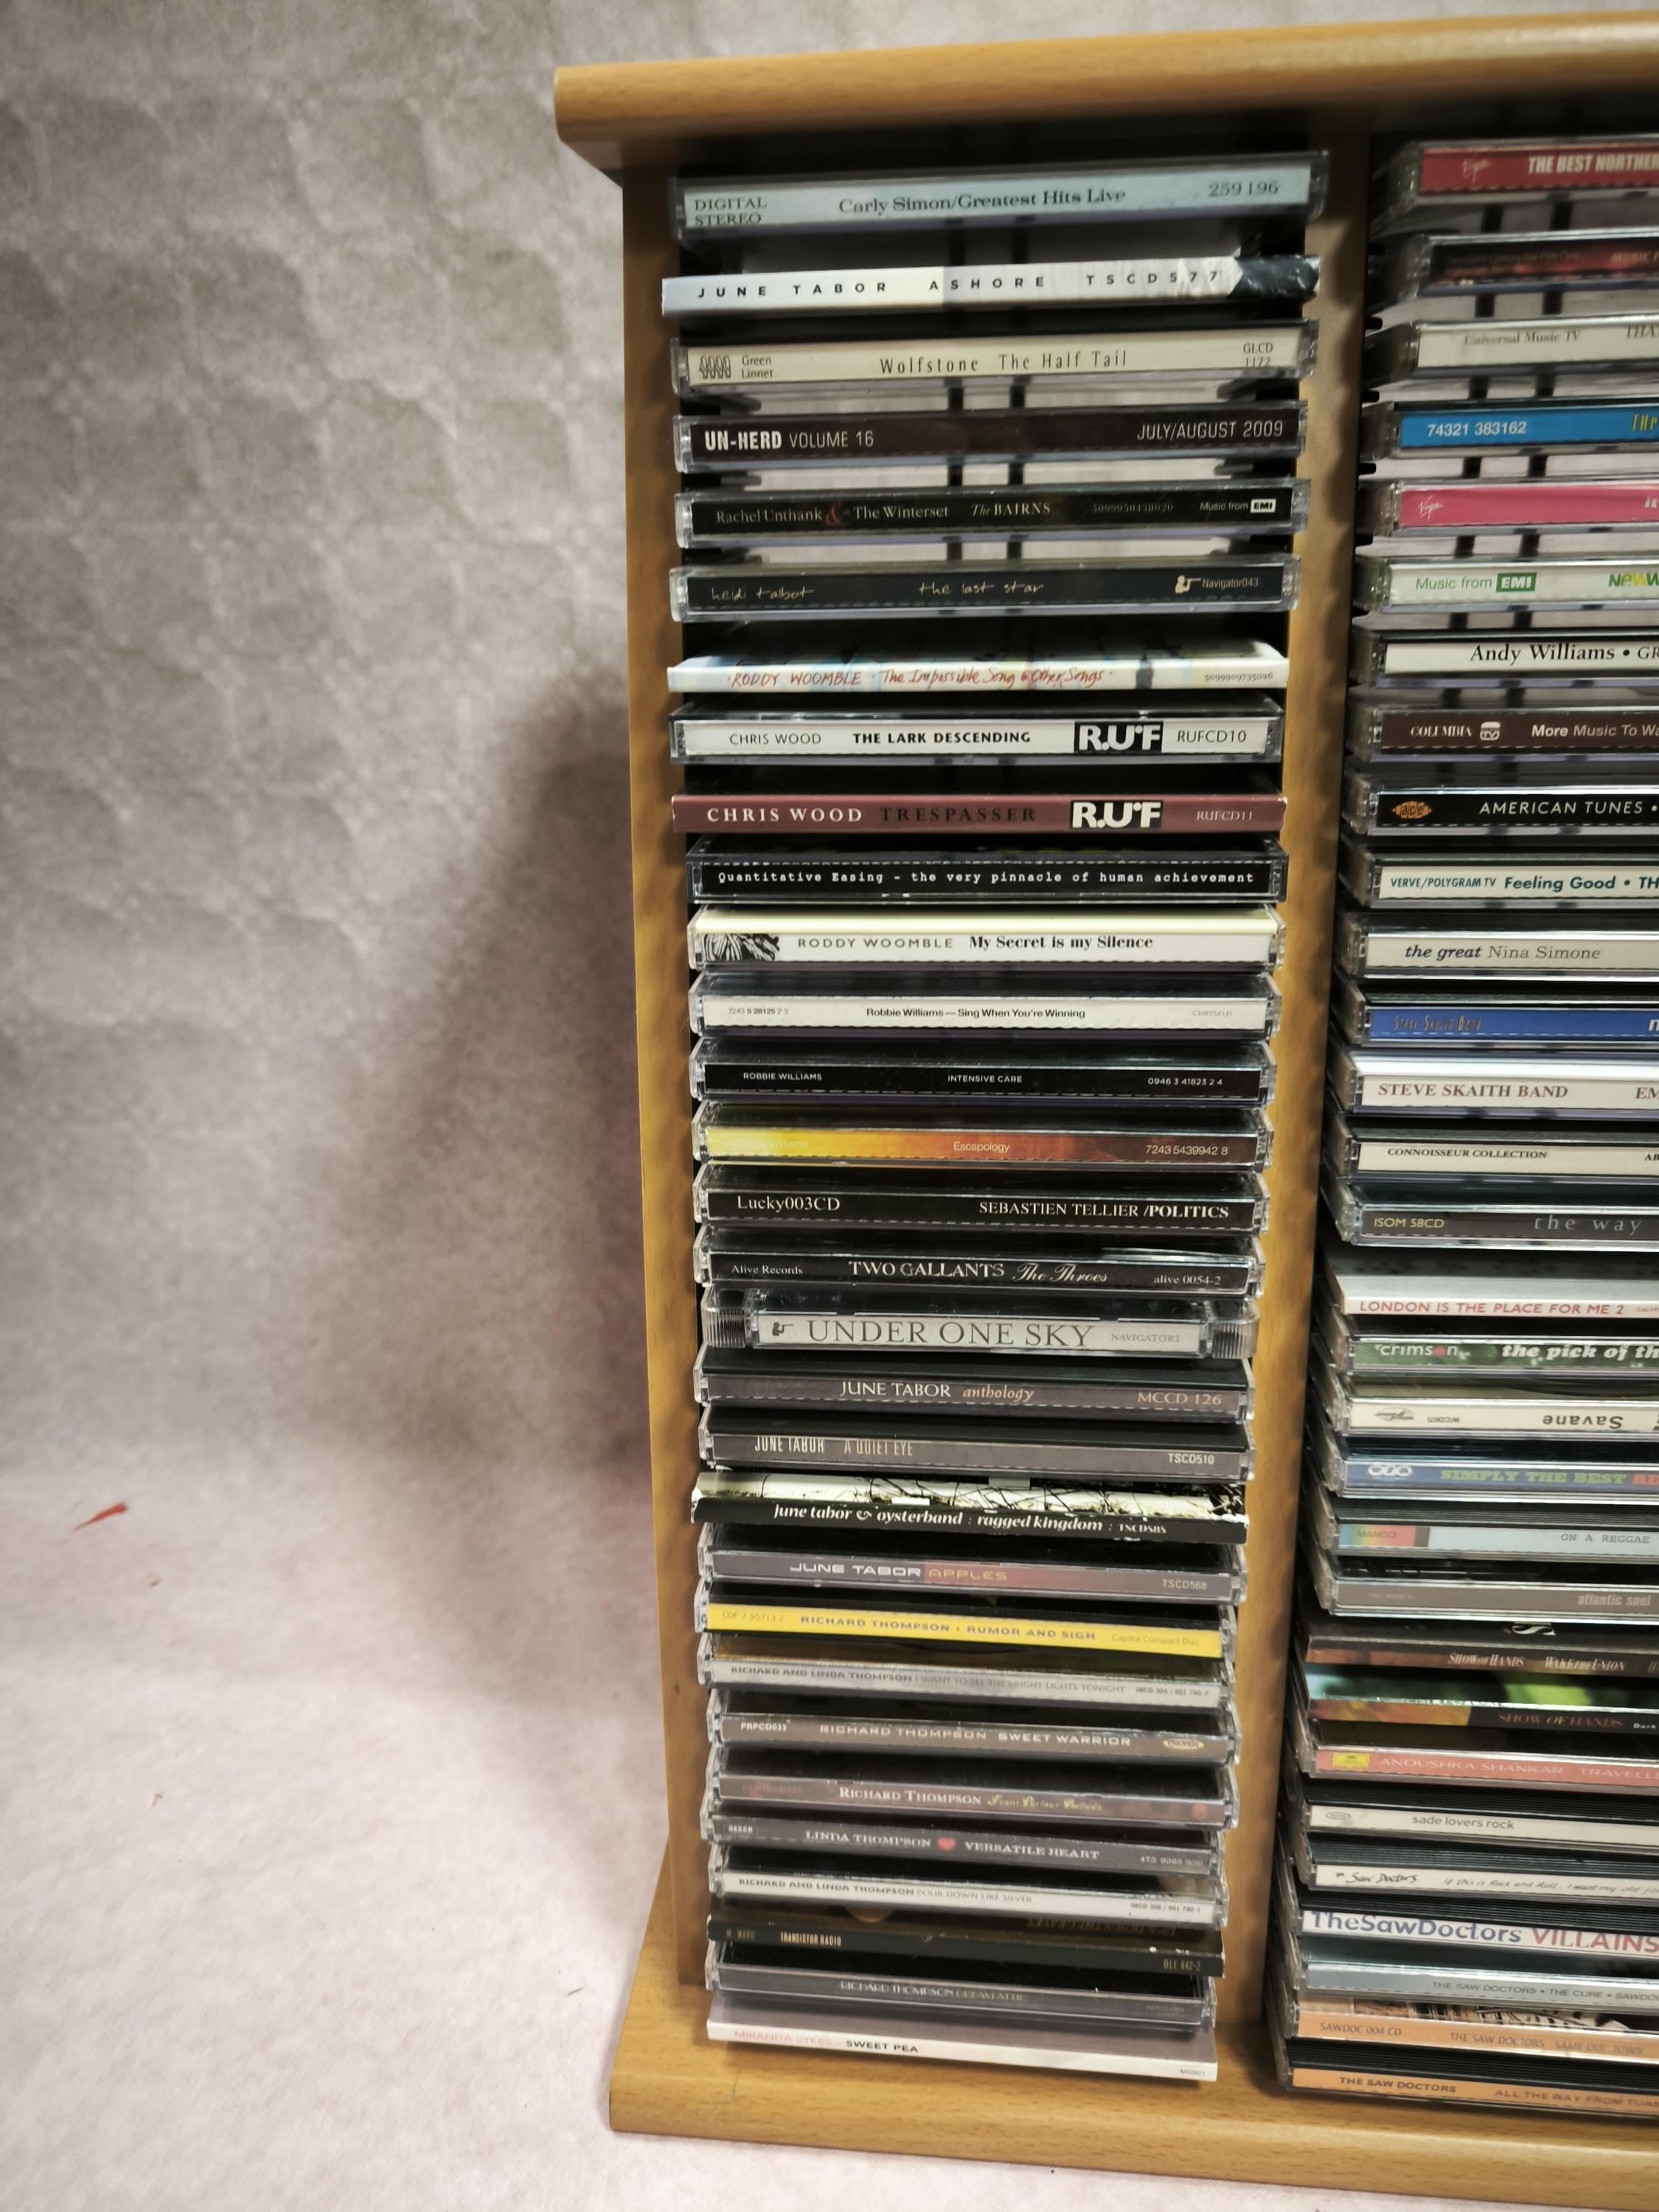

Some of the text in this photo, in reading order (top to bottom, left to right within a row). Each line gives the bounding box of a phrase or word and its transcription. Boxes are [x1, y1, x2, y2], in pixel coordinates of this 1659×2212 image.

[1528, 156, 1592, 174] THE BEST
[839, 189, 1125, 215] Carly Simon/Greatest Hits Live
[698, 271, 1217, 298] JUNE TABOR ASHORE TSCD577
[1243, 342, 1273, 354] GLCD
[742, 355, 772, 366] Green
[880, 350, 1127, 375] Wolfstone The Half Tail
[742, 369, 773, 379] Linnet
[1137, 420, 1283, 441] JULY/AUGUST 2009
[1427, 422, 1526, 437] 74321 383162
[705, 431, 874, 451] UN-HERD VOLUME 16
[972, 503, 1051, 516] The BAIRNS
[919, 581, 1044, 596] the last star
[1203, 577, 1259, 589] Navigator043
[712, 585, 814, 600] heidi talbot
[1470, 643, 1615, 666] Andy Williams
[730, 731, 1031, 745] CHRIS WOOD THE LARK DESCENDING
[1178, 731, 1246, 743] RUFCD10
[1411, 726, 1471, 737] COLUMBIA
[1532, 724, 1638, 737] More Music To
[707, 807, 1036, 822] CHRIS WOOD TRESPASSER
[1479, 801, 1643, 815] AMERICAN TUNES
[798, 936, 1153, 950] RODDY WOOMBLE My Secret is my Silence
[1405, 945, 1601, 961] the great Nina Simone
[867, 1008, 1085, 1019] Robbie Williams Sing When You're Winning
[1378, 1084, 1568, 1098] STEVE SKAITH BAND
[1388, 1149, 1547, 1158] CONNOISSEUR COLLECTION
[738, 1196, 840, 1213] Lucky003CD
[980, 1202, 1229, 1219] SEBASTIEN TELLIER /POLITICS
[1534, 1216, 1641, 1235] the way
[731, 1265, 803, 1275] Alive Records
[849, 1261, 1107, 1282] TWO GALLANTS The Throes
[1360, 1302, 1624, 1314] LONDON IS THE PLACE FOR ME 2
[807, 1321, 1095, 1346] UNDER ONE SKY
[841, 1381, 1034, 1402] JUNE TABOR anthology
[1138, 1392, 1222, 1405] MCCD 126
[1543, 1414, 1624, 1429] Savane
[755, 1436, 912, 1456] JUNE TABOR A QUIET EYE
[1168, 1453, 1214, 1465] TSCD510
[1441, 1470, 1627, 1484] SIMPLY THE BEST
[790, 1564, 1007, 1581] JUNE TABOR APPLES
[1162, 1579, 1207, 1590] TSCD568
[1578, 1594, 1651, 1607] atlantic soul
[801, 1615, 1096, 1640] RICHARD THOMPSON RUMOR AND SIGH
[820, 1725, 1130, 1747] RICHARD THOMPSON SWEET WARRIOR
[1380, 1758, 1475, 1770] ANOUSHKA
[1480, 1761, 1564, 1775] SHANKAR
[1412, 1815, 1514, 1829] sade lovers rock
[806, 1831, 1099, 1859] LINDA THOMPSON VERSATILE HEART
[1311, 1911, 1522, 1944] TheSawDoctors
[781, 1932, 841, 1946] TRANSISTOR RADIO
[1433, 1981, 1453, 1989] THE
[1484, 1985, 1536, 1994] DOCTORS
[1572, 1990, 1603, 1998] CURE
[846, 2040, 918, 2053] SWEET PEA
[1340, 2077, 1582, 2102] THE SAW DOCTORS ALL THE WAY
